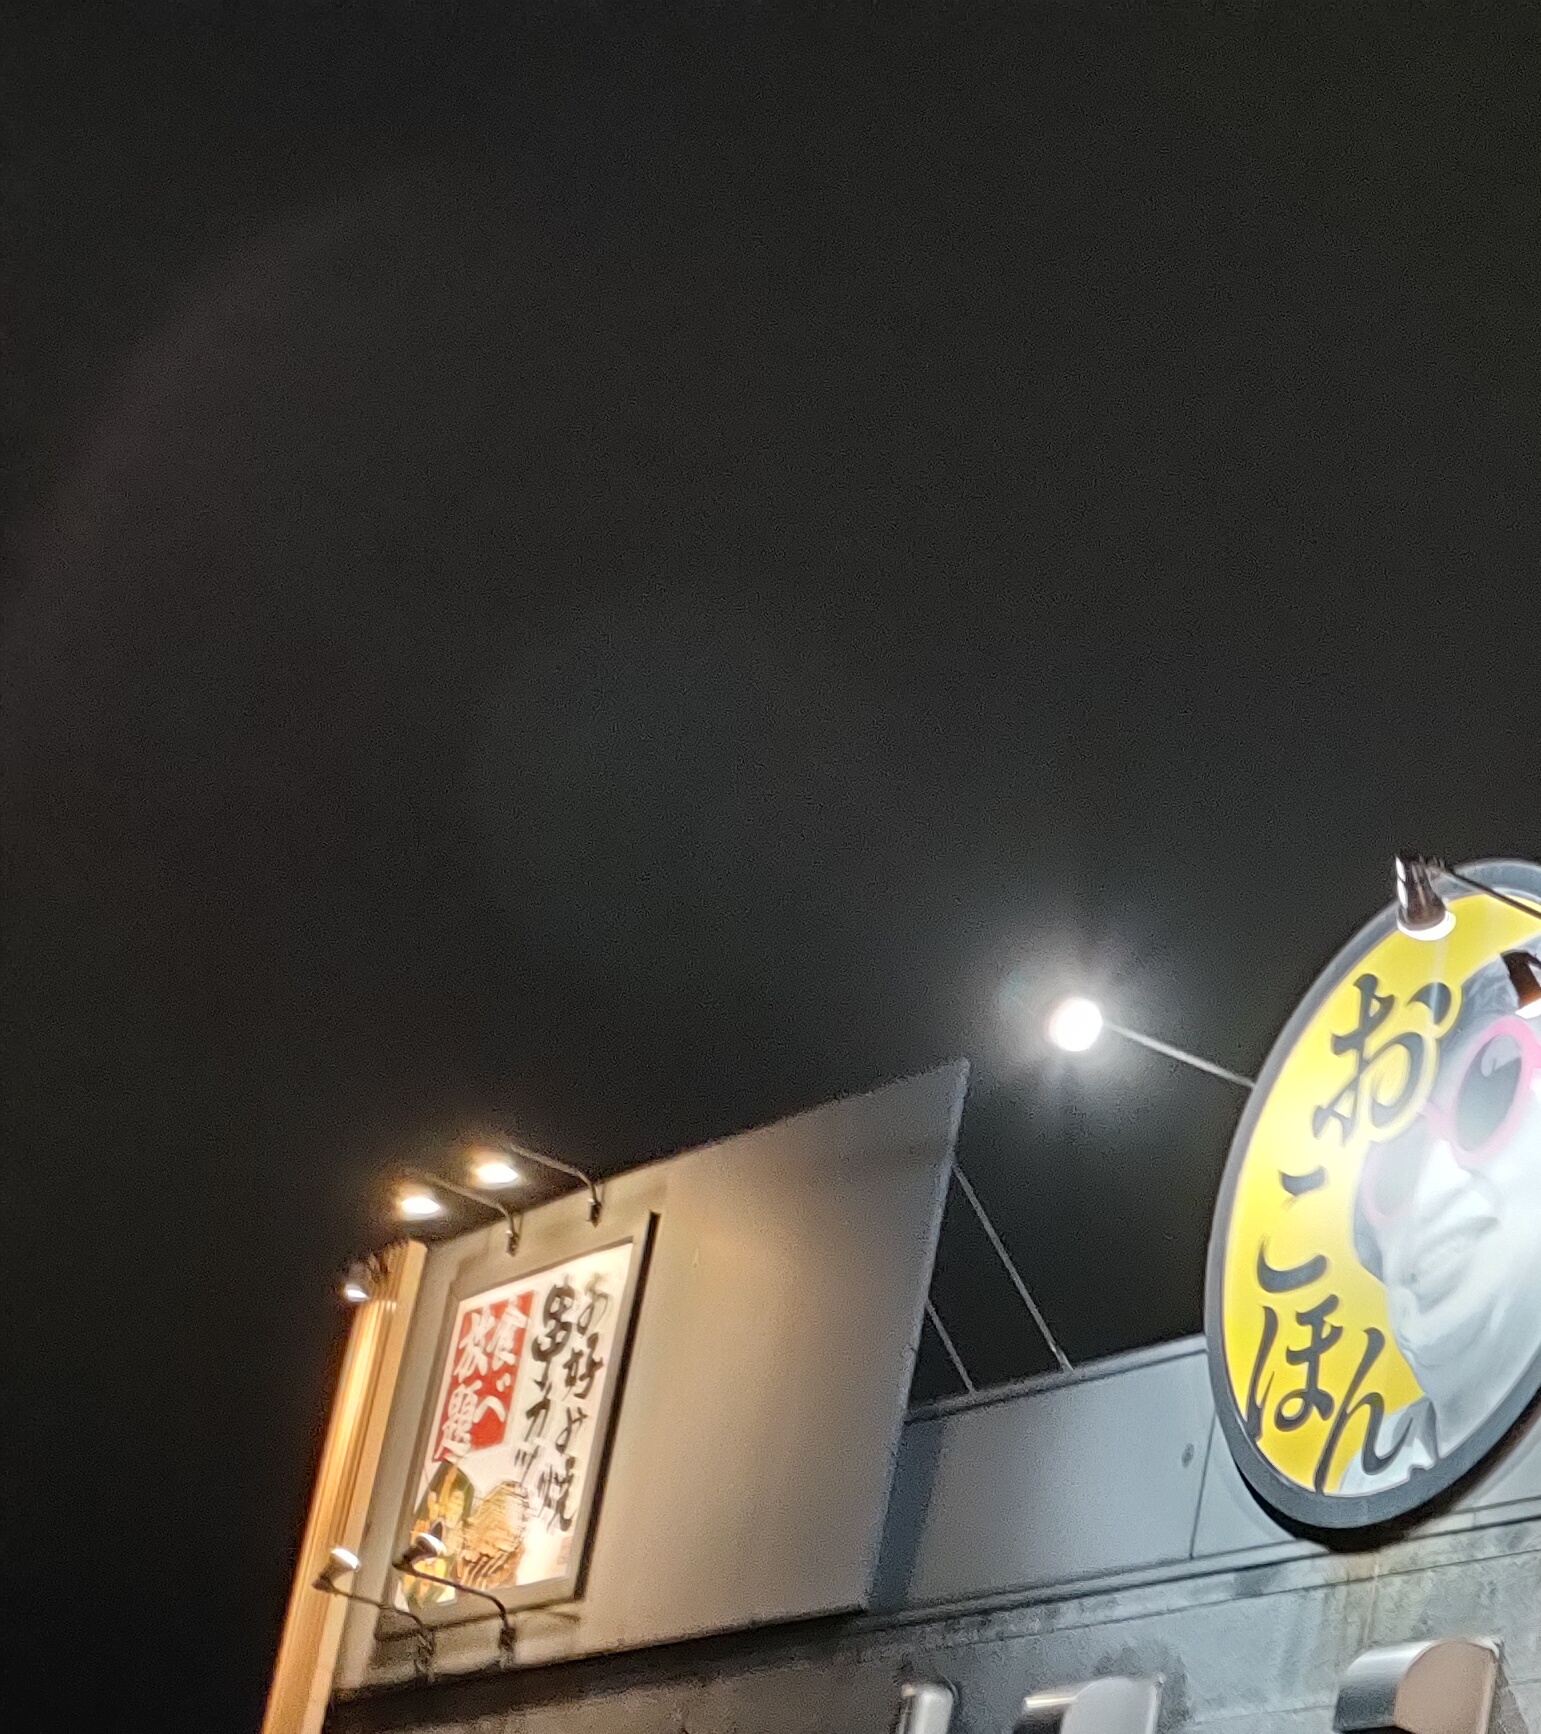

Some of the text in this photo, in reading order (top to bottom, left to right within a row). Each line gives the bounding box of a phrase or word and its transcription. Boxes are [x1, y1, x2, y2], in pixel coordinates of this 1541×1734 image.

[516, 1272, 576, 1488] 串カツ
[542, 1272, 606, 1533] お好み焼
